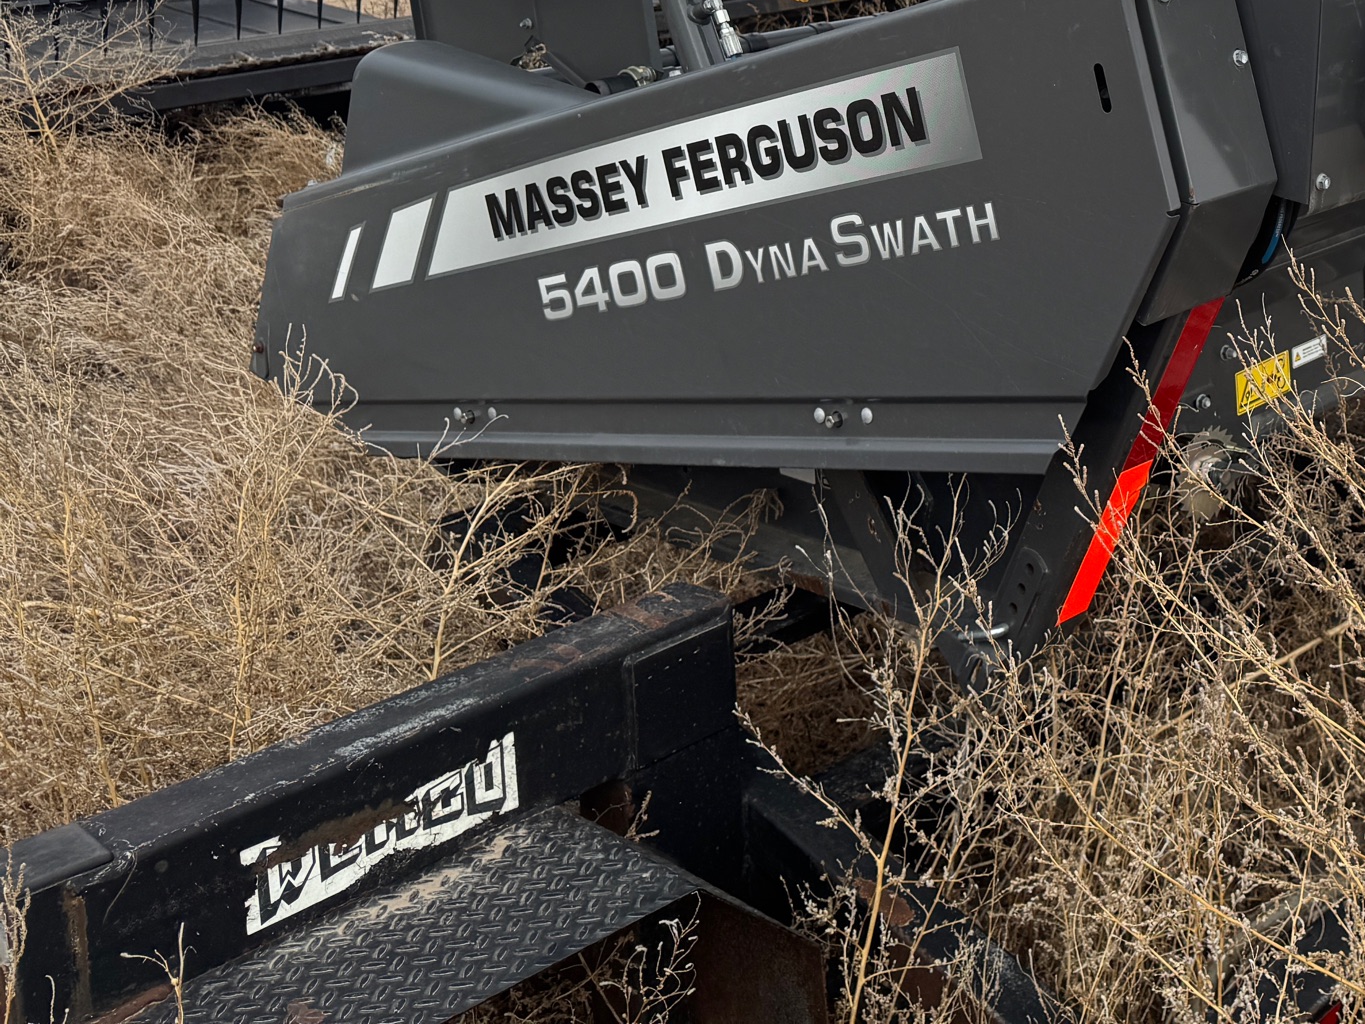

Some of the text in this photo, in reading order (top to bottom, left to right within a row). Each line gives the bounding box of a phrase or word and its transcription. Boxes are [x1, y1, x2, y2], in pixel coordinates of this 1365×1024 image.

[484, 86, 929, 242] MASSEY FERGUSON
[537, 250, 688, 321] 5400
